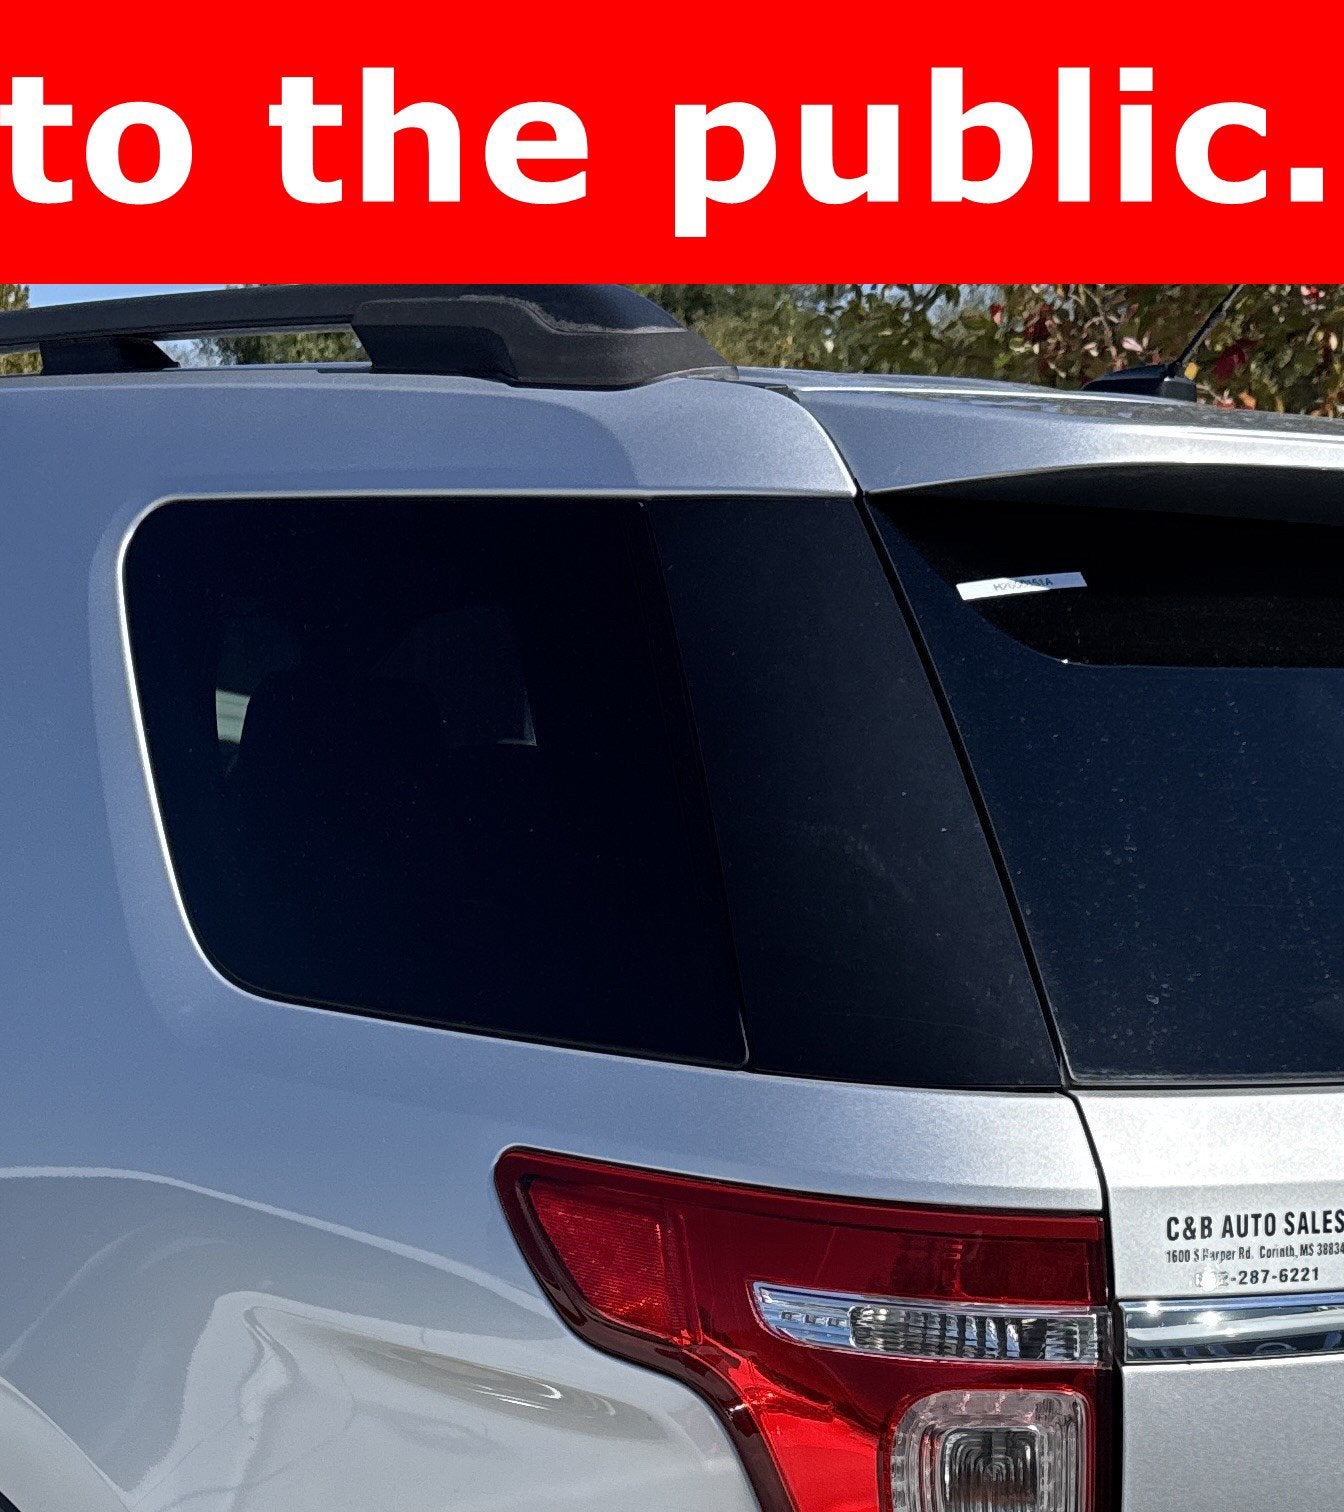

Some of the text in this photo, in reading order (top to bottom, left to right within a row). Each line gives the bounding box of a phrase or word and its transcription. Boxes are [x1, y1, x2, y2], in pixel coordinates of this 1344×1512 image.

[1166, 1215, 1213, 1241] C&B
[1221, 1212, 1276, 1239] AUTO
[1300, 1242, 1314, 1256] MS
[1195, 1266, 1319, 1288] 2-287-6221
